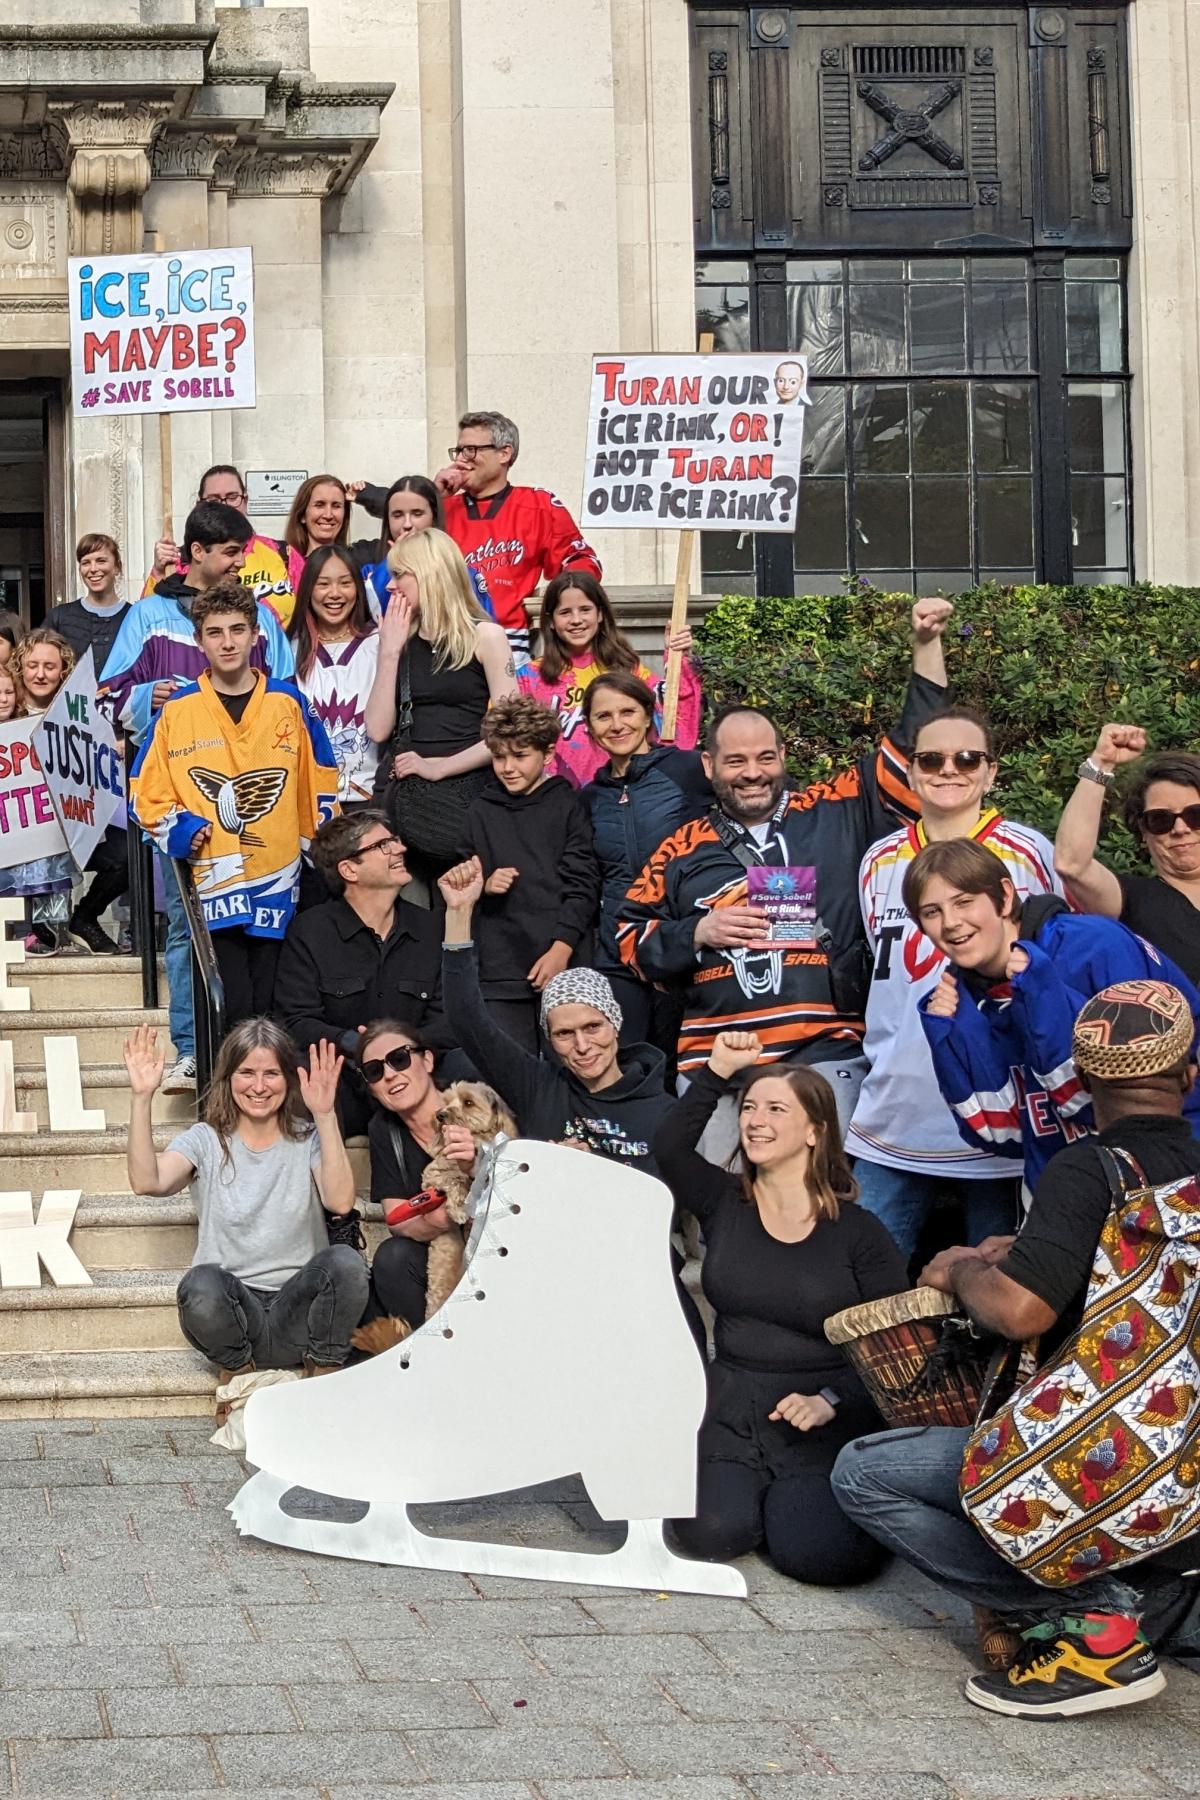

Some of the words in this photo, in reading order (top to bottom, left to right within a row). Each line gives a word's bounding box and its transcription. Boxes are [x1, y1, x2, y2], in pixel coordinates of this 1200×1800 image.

[84, 316, 247, 375] MAYBE?
[163, 377, 235, 400] SOBELL
[596, 362, 702, 406] TURAN
[707, 375, 769, 405] OUR
[593, 449, 659, 477] NOT
[668, 448, 773, 484] TURAN
[587, 483, 653, 516] OUR
[464, 537, 525, 565] atham
[65, 691, 89, 726] WE
[197, 736, 225, 749] Stanle
[61, 793, 96, 827] WANT
[750, 893, 781, 901] #Save
[782, 893, 813, 901] Sobell
[764, 903, 778, 913] Ice
[779, 903, 802, 913] Rink
[783, 953, 830, 966] SABR
